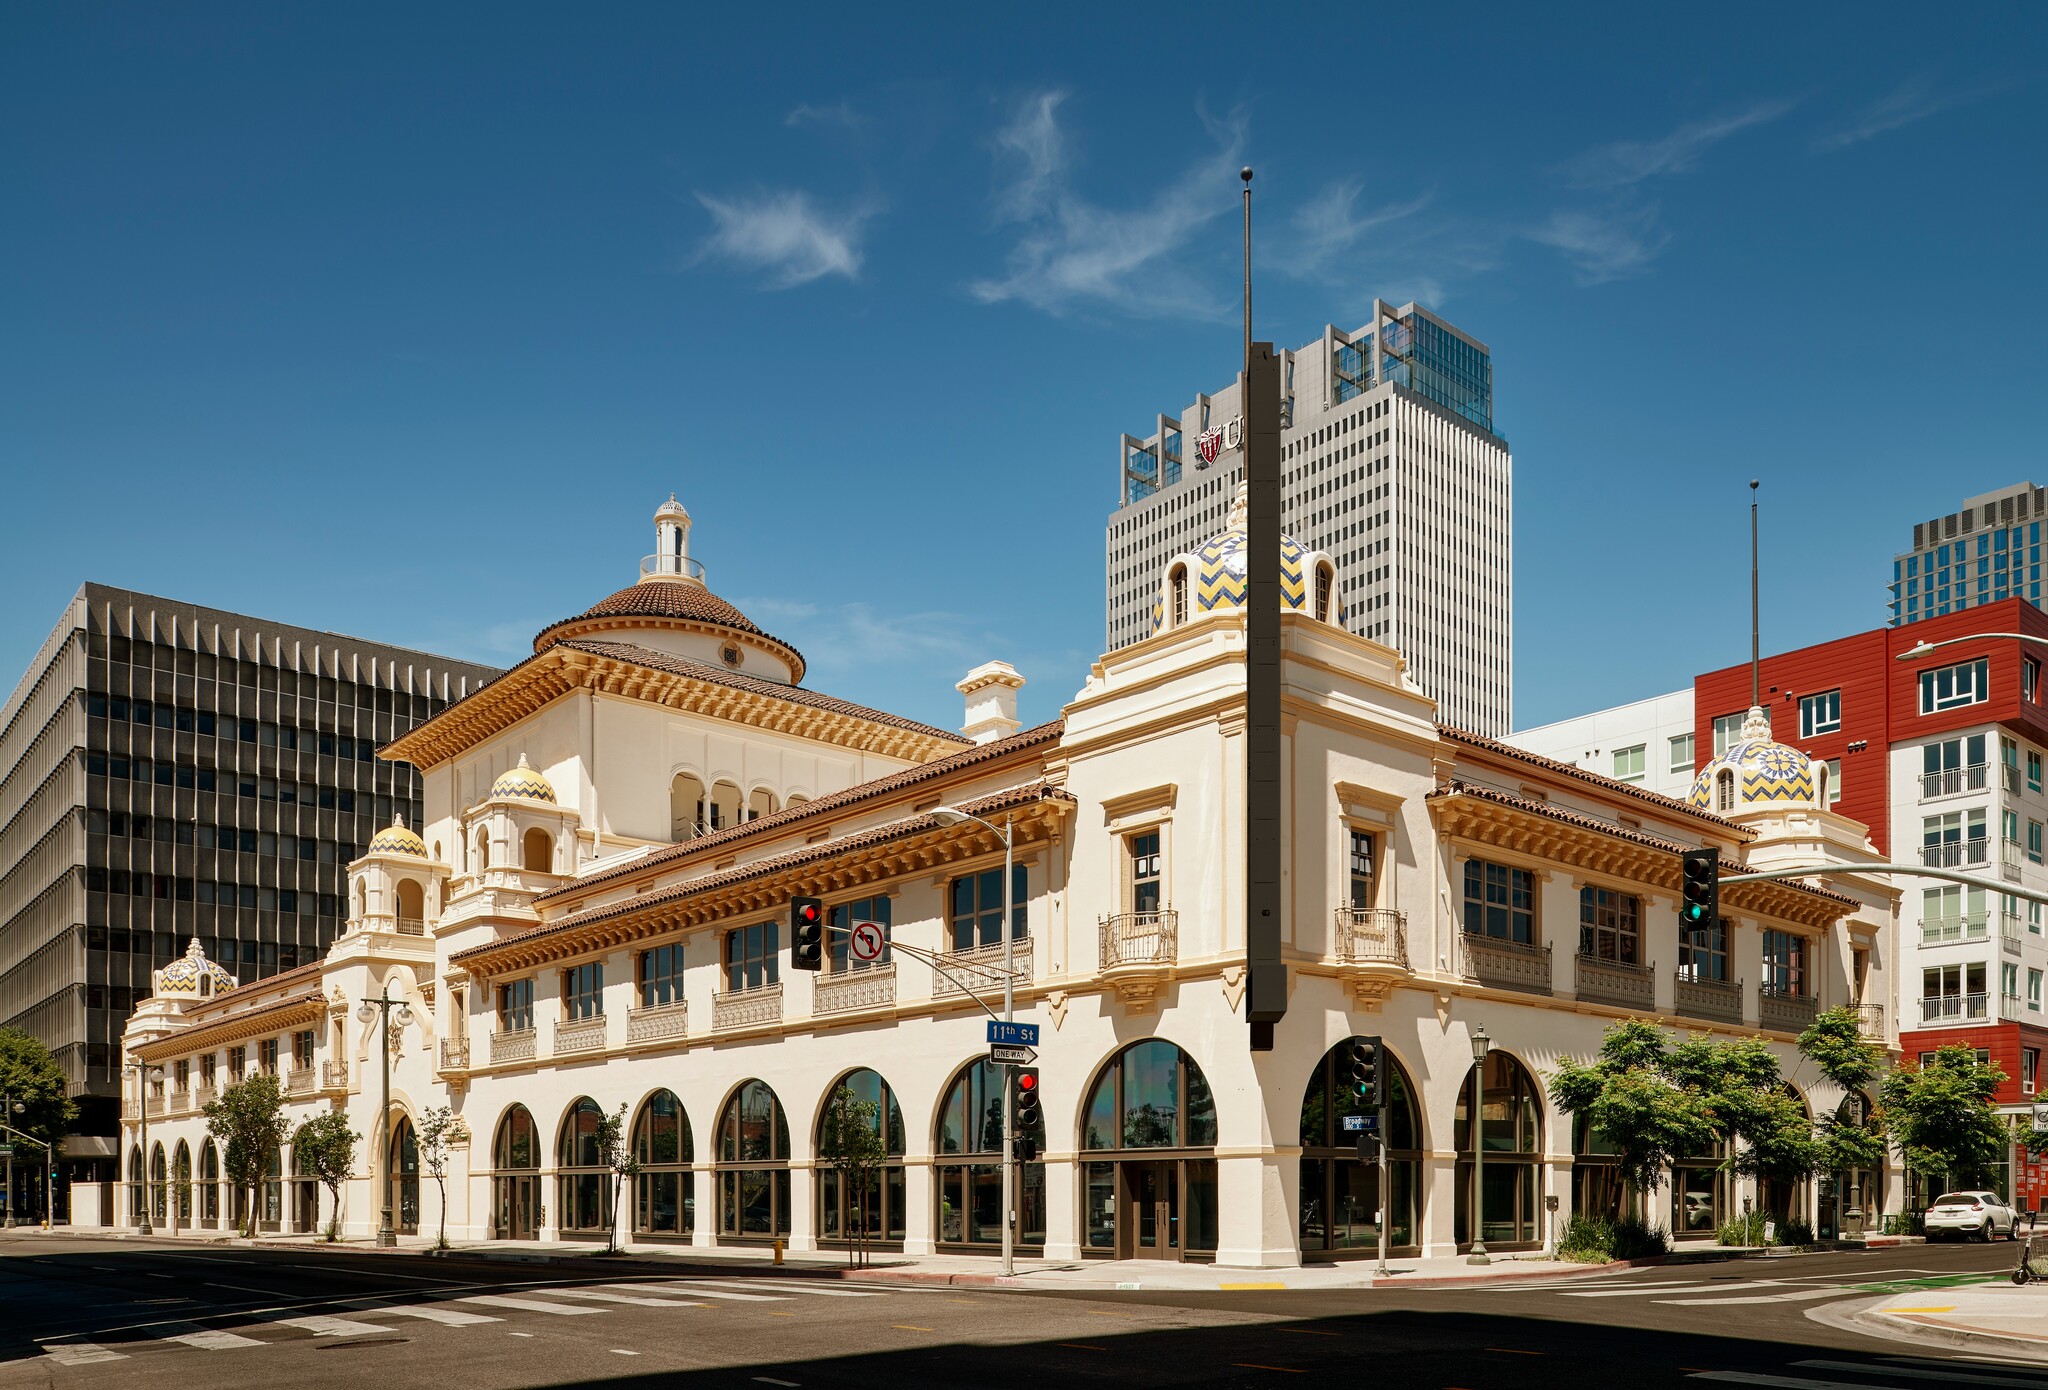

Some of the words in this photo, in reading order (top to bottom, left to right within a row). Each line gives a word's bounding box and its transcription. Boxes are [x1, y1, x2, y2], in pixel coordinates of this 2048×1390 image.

[993, 1025, 1016, 1040] 11th
[1020, 1029, 1034, 1041] St
[995, 1049, 1009, 1058] ONE
[1011, 1050, 1025, 1059] WAY
[1345, 1117, 1371, 1126] Broadway
